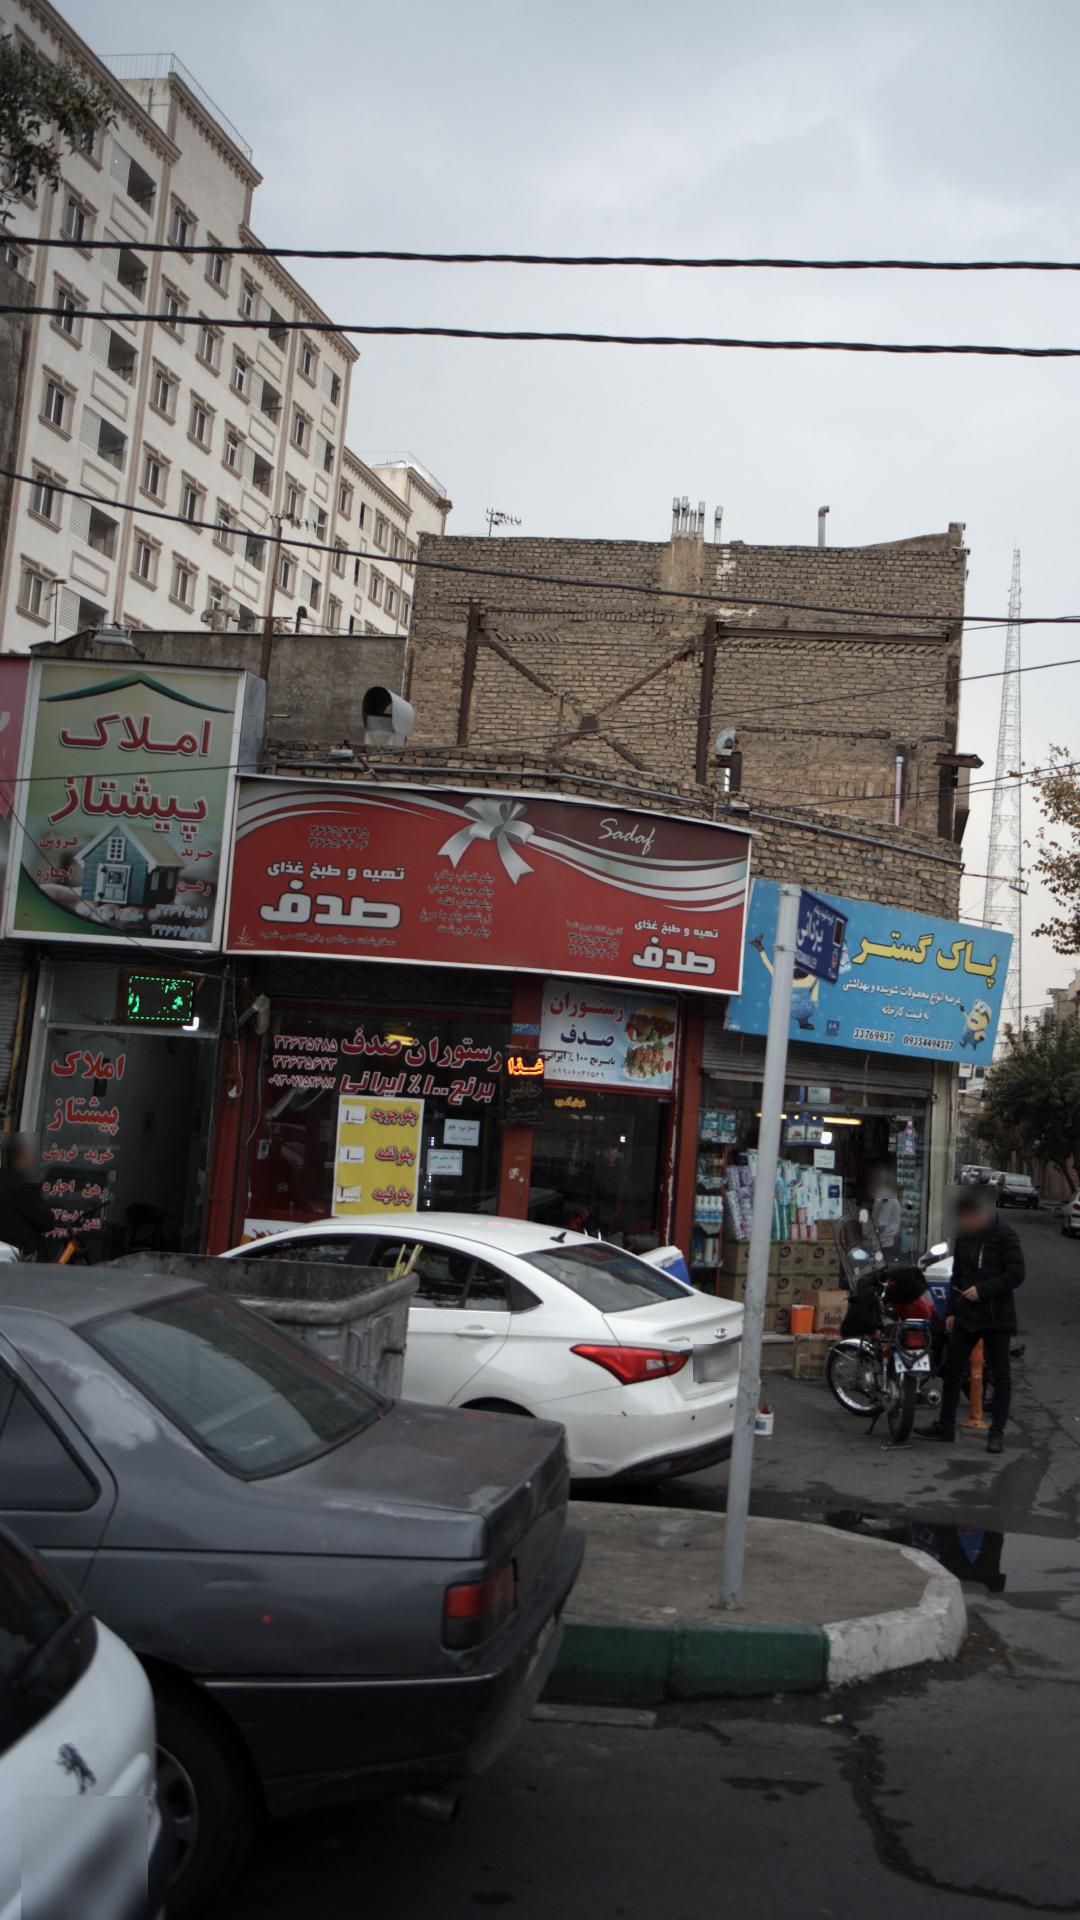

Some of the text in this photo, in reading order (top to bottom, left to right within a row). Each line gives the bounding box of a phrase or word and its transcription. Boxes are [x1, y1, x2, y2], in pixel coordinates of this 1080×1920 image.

[60, 713, 212, 757] املاک
[48, 774, 208, 842] پیشتاز
[39, 833, 79, 848] فروش
[598, 818, 656, 856] Sadaf
[267, 860, 405, 883] تهیه و طبخ غذای
[259, 879, 401, 928] صدف
[633, 919, 659, 931] غذای
[661, 922, 680, 935] طبخ
[683, 927, 690, 937] و
[693, 929, 719, 940] تهیه
[797, 910, 824, 953] یزدانی
[632, 936, 716, 975] صدف
[852, 930, 934, 965] گستر
[936, 939, 997, 989] پاک
[842, 977, 961, 1006] عرضه انواع محصولات شوینده و بهداشتی
[549, 991, 624, 1024] رستوران
[905, 1009, 923, 1022] قیمت
[341, 1027, 503, 1072] رستوران صدف
[560, 1024, 615, 1048] صدف
[51, 1050, 126, 1080] املاک
[507, 1056, 544, 1076] غذا
[340, 1070, 407, 1097] ایرانی
[449, 1076, 496, 1105] برنج
[47, 1096, 119, 1136] پیشتاز
[371, 1105, 418, 1127] چلو جوجه
[42, 1142, 114, 1165] خرید فروش
[396, 1146, 416, 1167] چلو
[42, 1178, 76, 1198] اجاره
[372, 1184, 413, 1207] چلو قیمه
